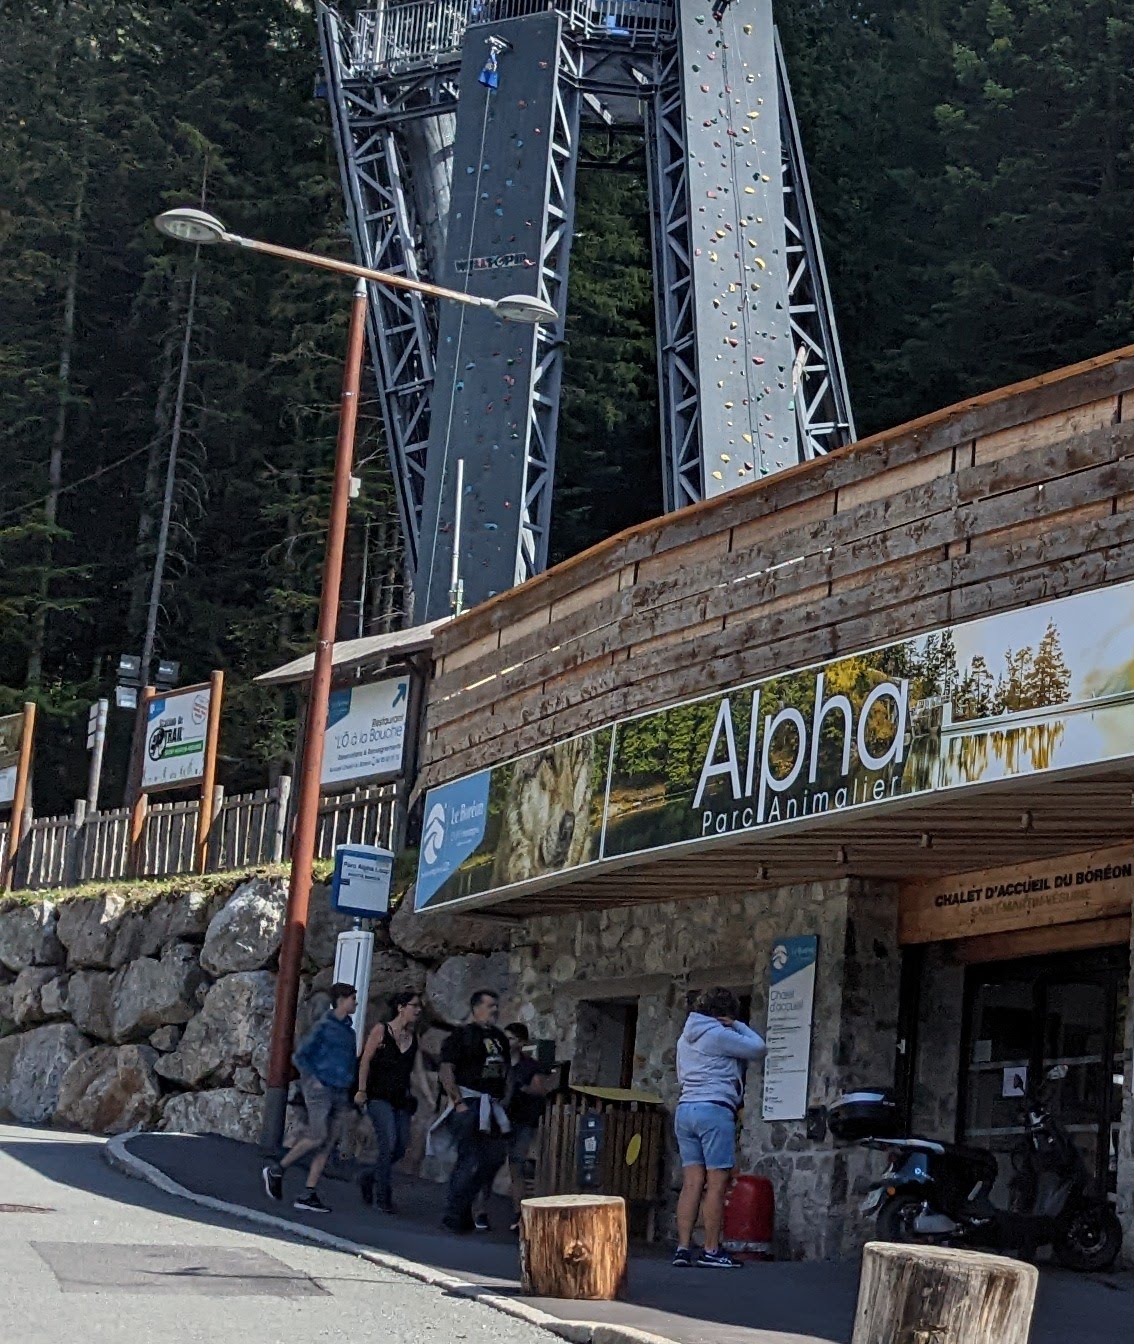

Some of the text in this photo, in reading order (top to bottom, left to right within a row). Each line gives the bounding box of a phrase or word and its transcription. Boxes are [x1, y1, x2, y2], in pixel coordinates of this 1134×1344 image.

[371, 714, 404, 728] Restaurant
[692, 672, 909, 824] Alpha
[451, 800, 484, 825] Le Boréon
[702, 775, 899, 837] Parc Animalier
[934, 863, 1132, 908] CHALET D'ACCUEIL DU BORÉON
